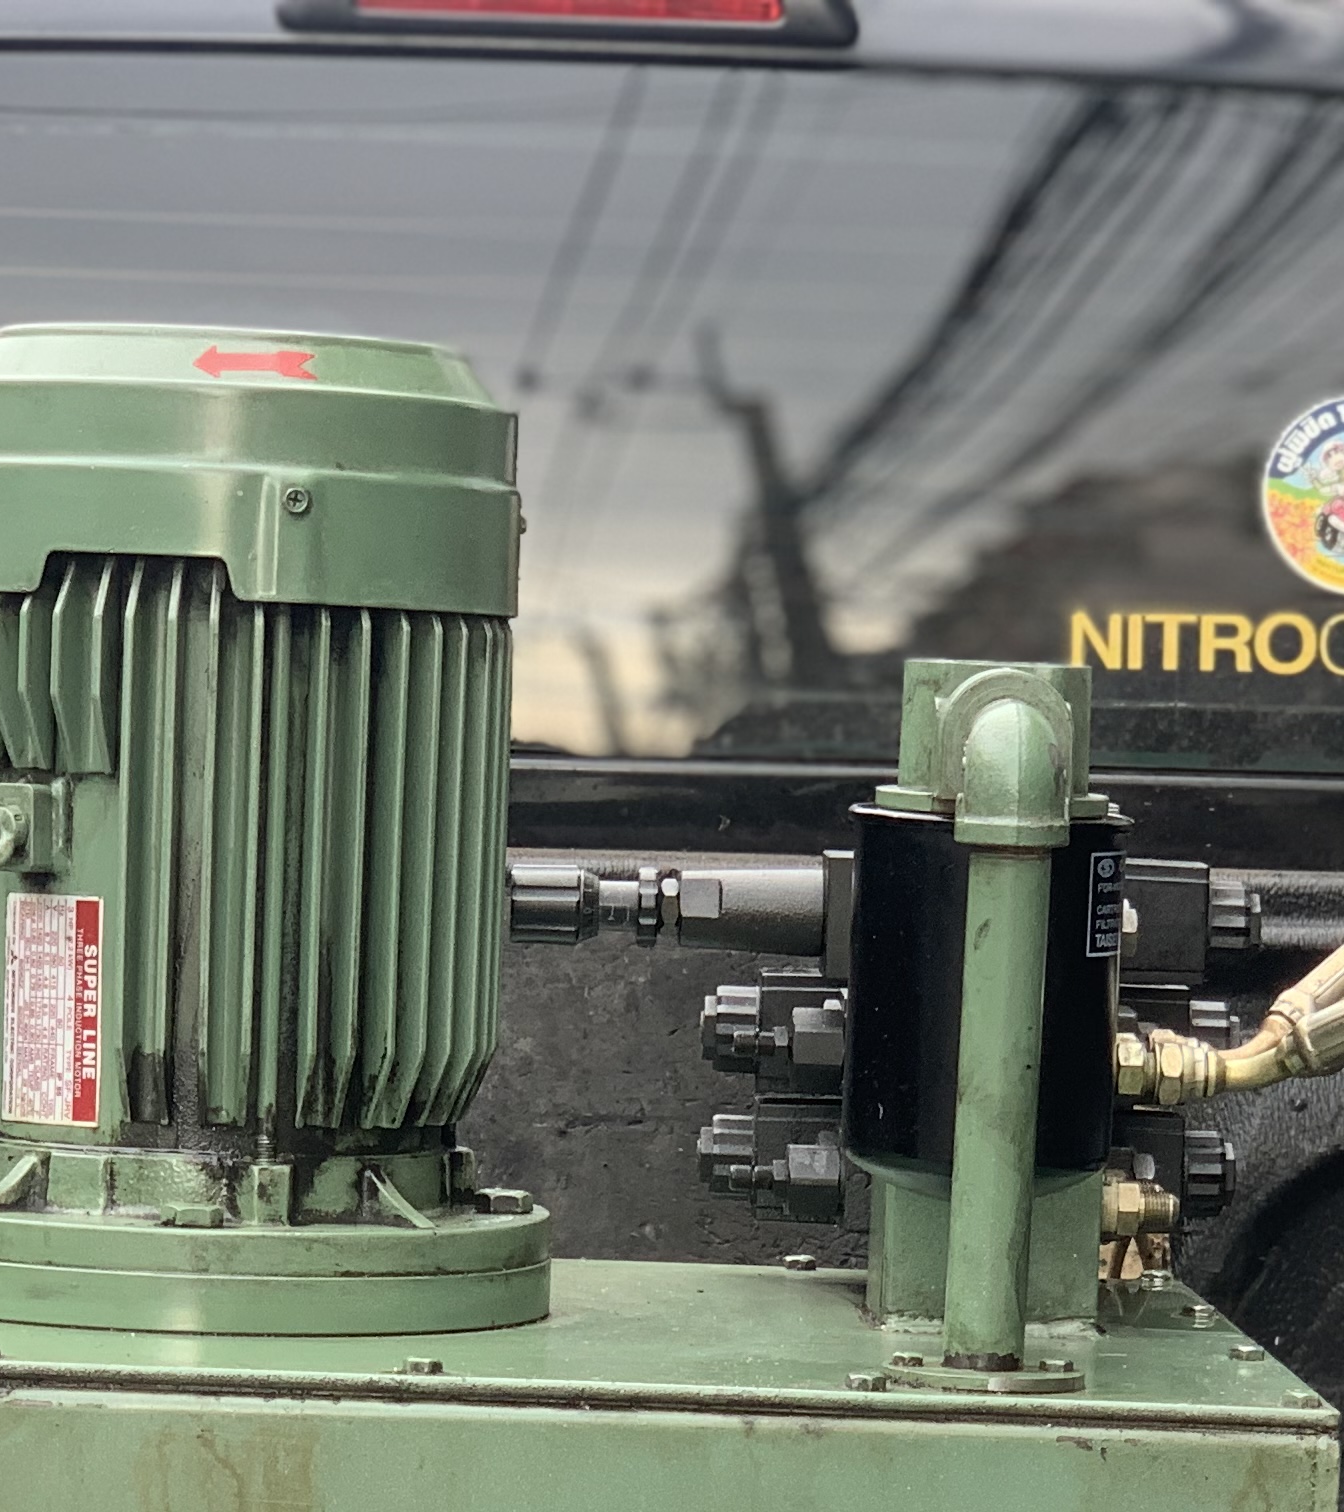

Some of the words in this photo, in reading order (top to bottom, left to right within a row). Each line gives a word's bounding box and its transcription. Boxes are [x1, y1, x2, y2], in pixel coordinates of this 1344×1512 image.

[76, 929, 84, 962] THREE
[75, 965, 83, 998] PHASE
[83, 944, 97, 1017] SUPER
[74, 1002, 82, 1056] INDUCTION
[82, 1029, 96, 1080] LINE
[74, 1061, 82, 1098] MOTOR
